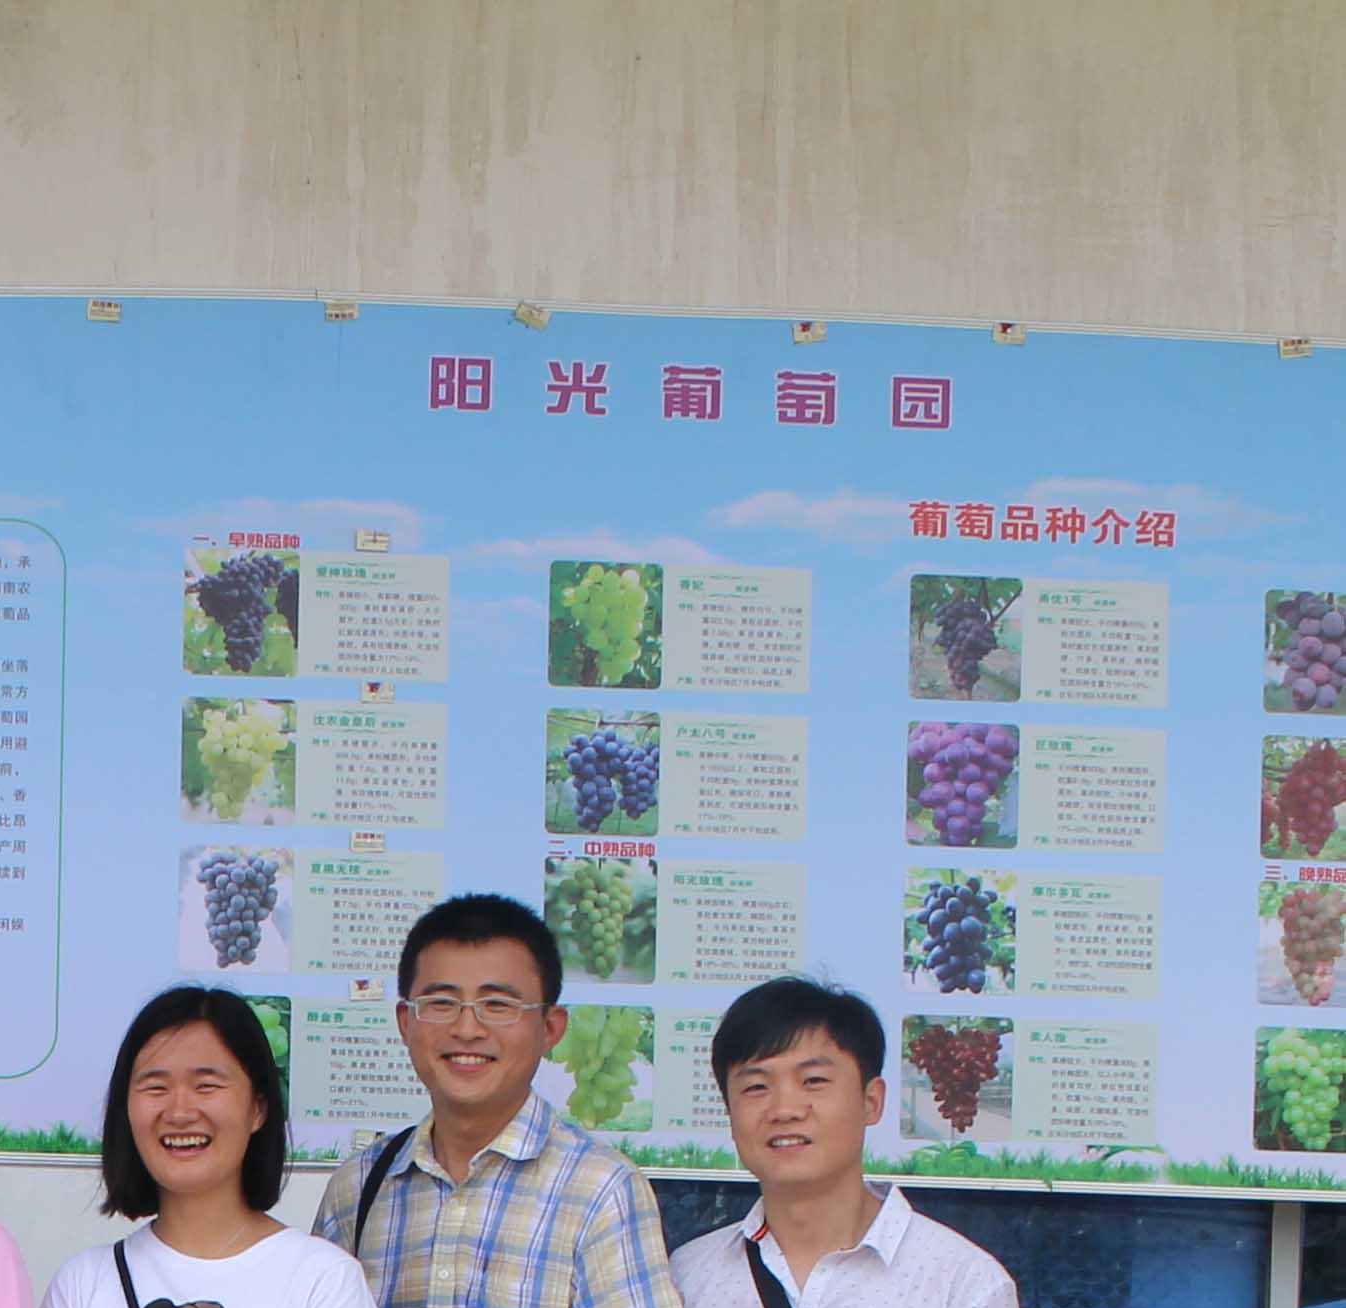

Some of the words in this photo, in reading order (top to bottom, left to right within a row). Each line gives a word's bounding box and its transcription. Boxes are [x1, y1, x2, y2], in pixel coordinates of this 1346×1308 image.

[429, 357, 954, 430] 阳光葡萄园
[192, 532, 301, 549] 一、早熟品种
[908, 501, 1177, 548] 葡萄品种介绍
[548, 840, 656, 857] 二、中熟品种
